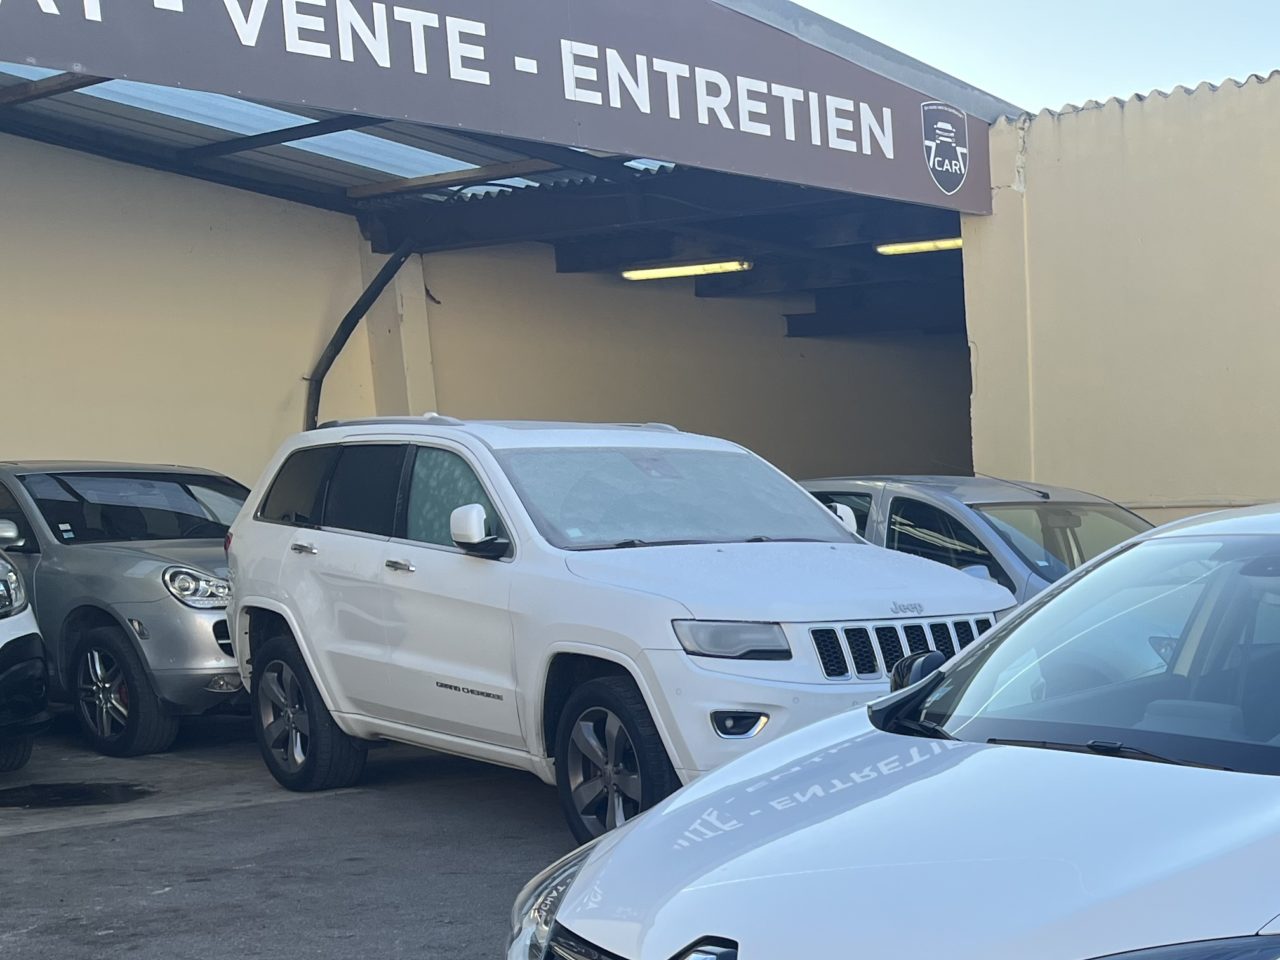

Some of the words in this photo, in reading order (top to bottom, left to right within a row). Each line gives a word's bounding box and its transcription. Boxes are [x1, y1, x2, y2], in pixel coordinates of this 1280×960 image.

[223, 0, 491, 85] VENTE
[560, 38, 895, 160] ENTRETIEN
[890, 600, 924, 615] Jeep
